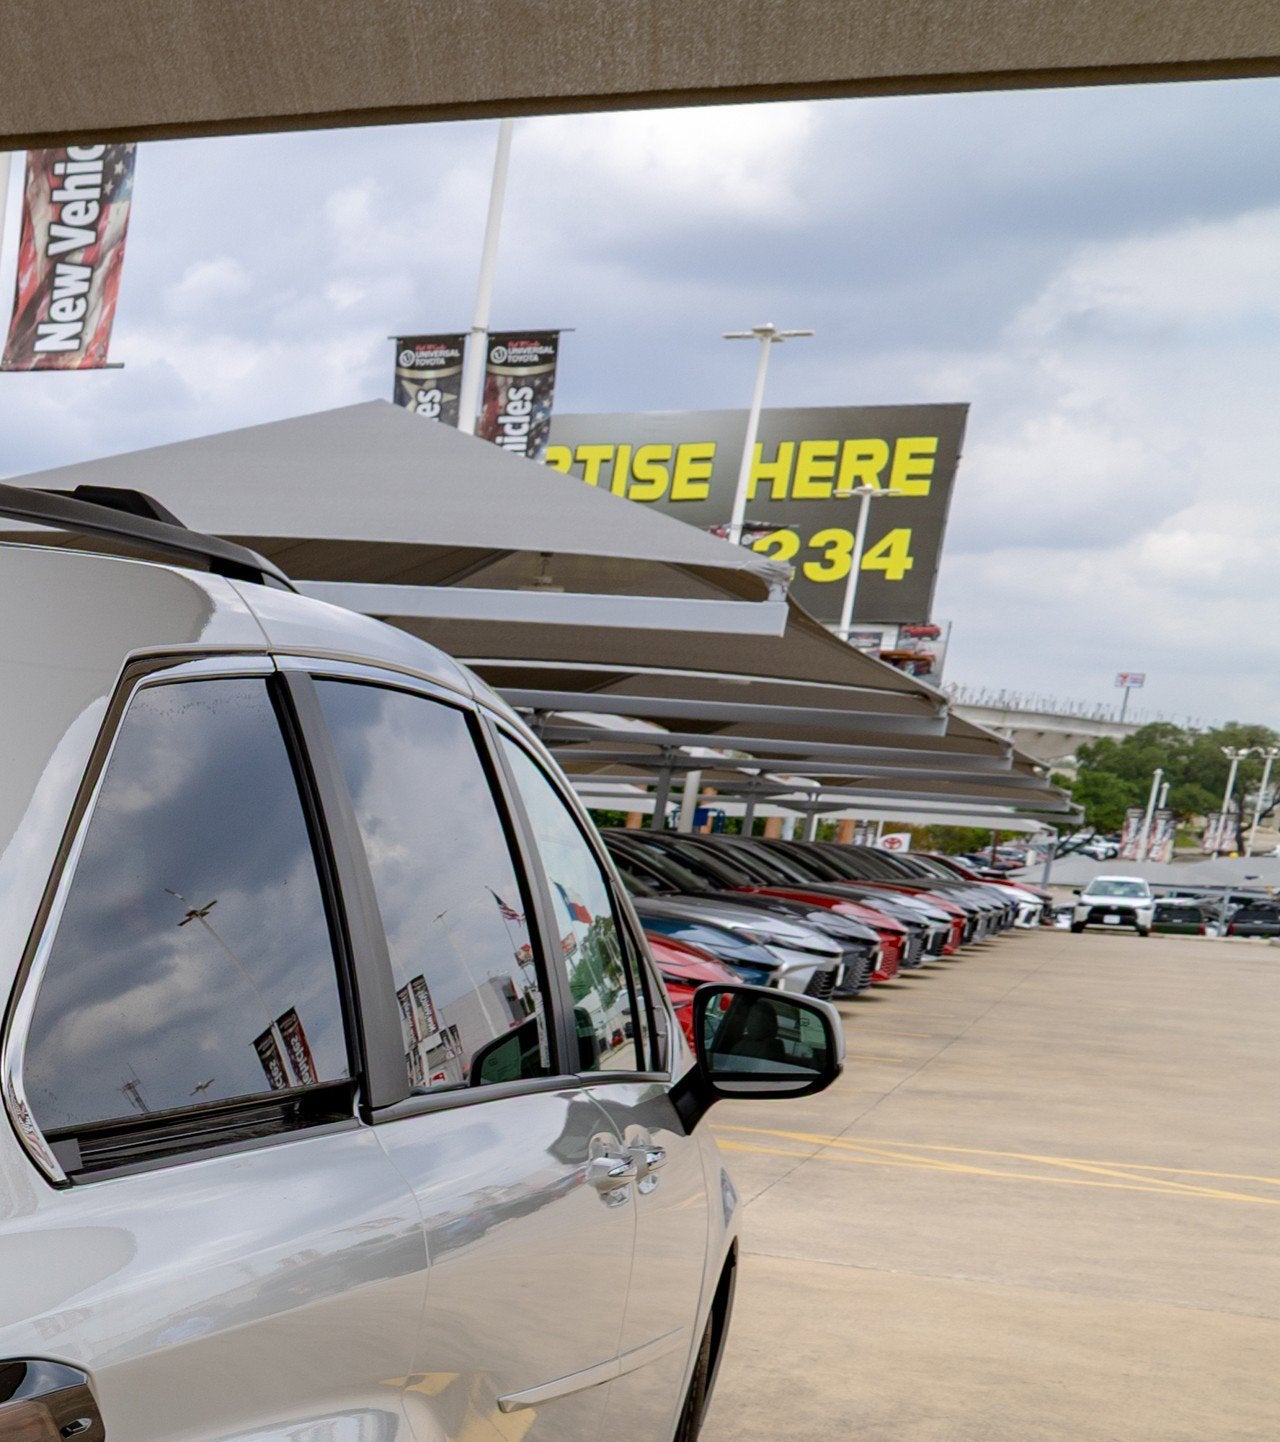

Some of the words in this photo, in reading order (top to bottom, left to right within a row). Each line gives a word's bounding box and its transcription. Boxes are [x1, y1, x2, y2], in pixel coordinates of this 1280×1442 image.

[46, 144, 106, 256] Vehic
[33, 262, 93, 352] New
[745, 437, 938, 500] HERE
